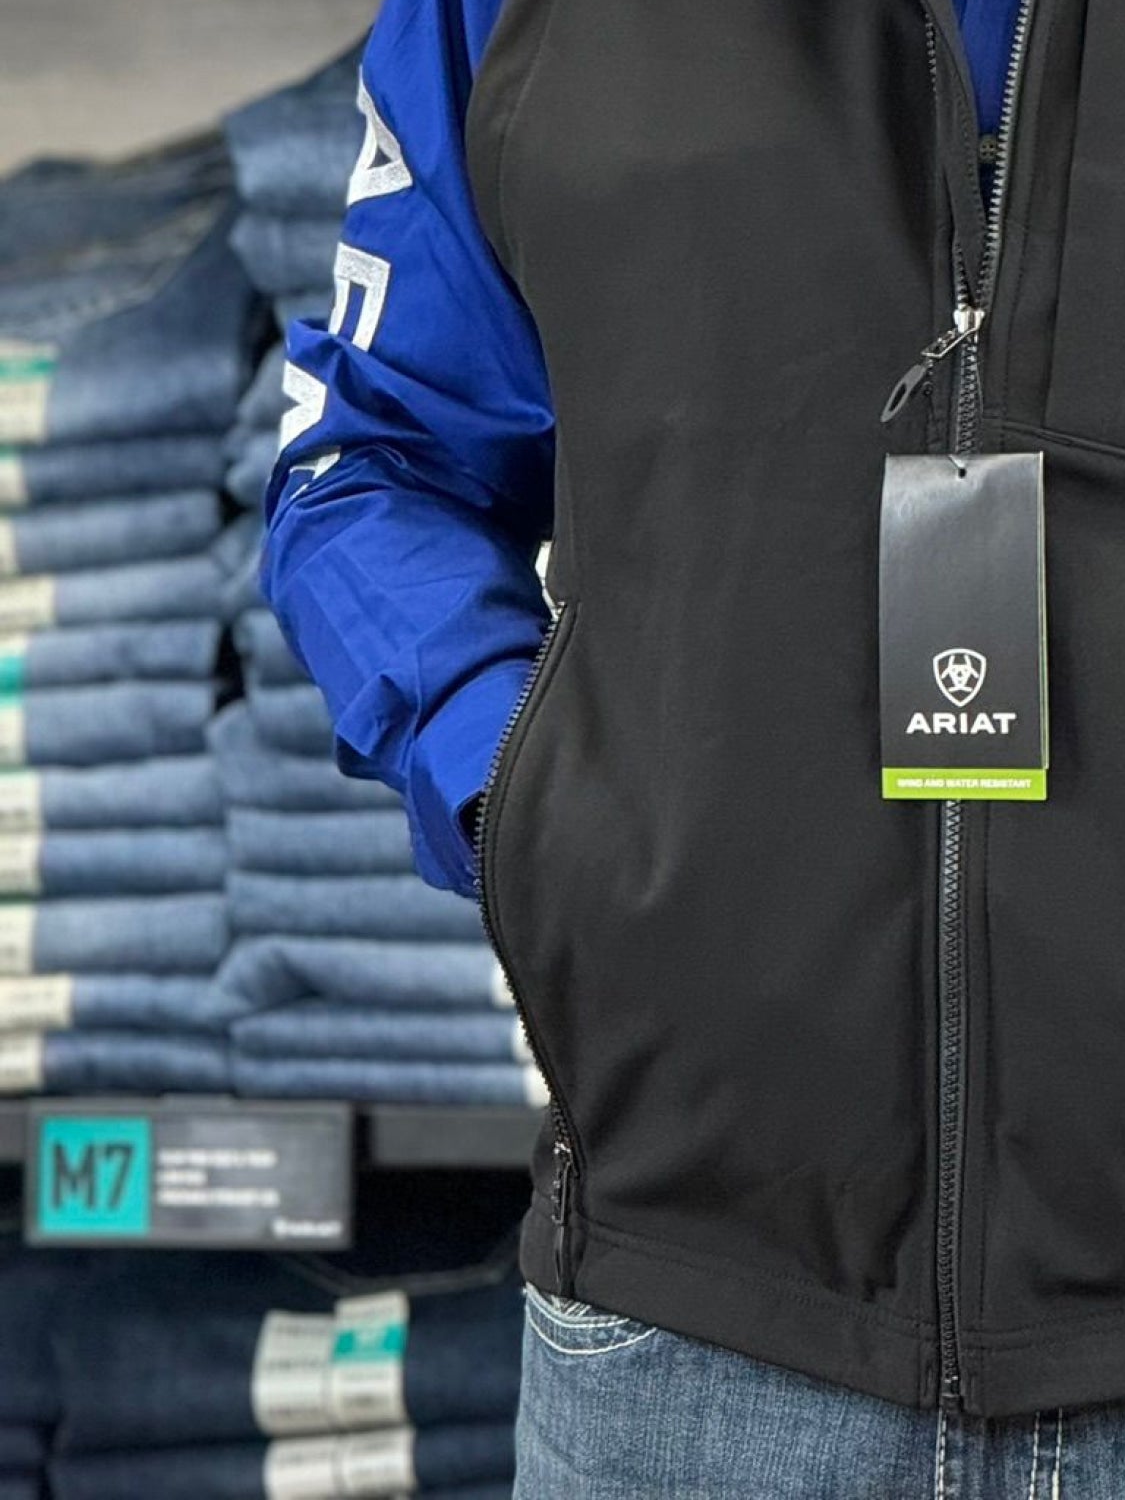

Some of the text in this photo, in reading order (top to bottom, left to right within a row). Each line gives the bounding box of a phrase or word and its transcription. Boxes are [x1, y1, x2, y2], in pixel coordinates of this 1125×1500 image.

[906, 711, 1016, 735] ARIAT
[946, 778, 979, 789] WATER
[980, 778, 1032, 789] RESISTANT
[53, 1140, 134, 1211] M7
